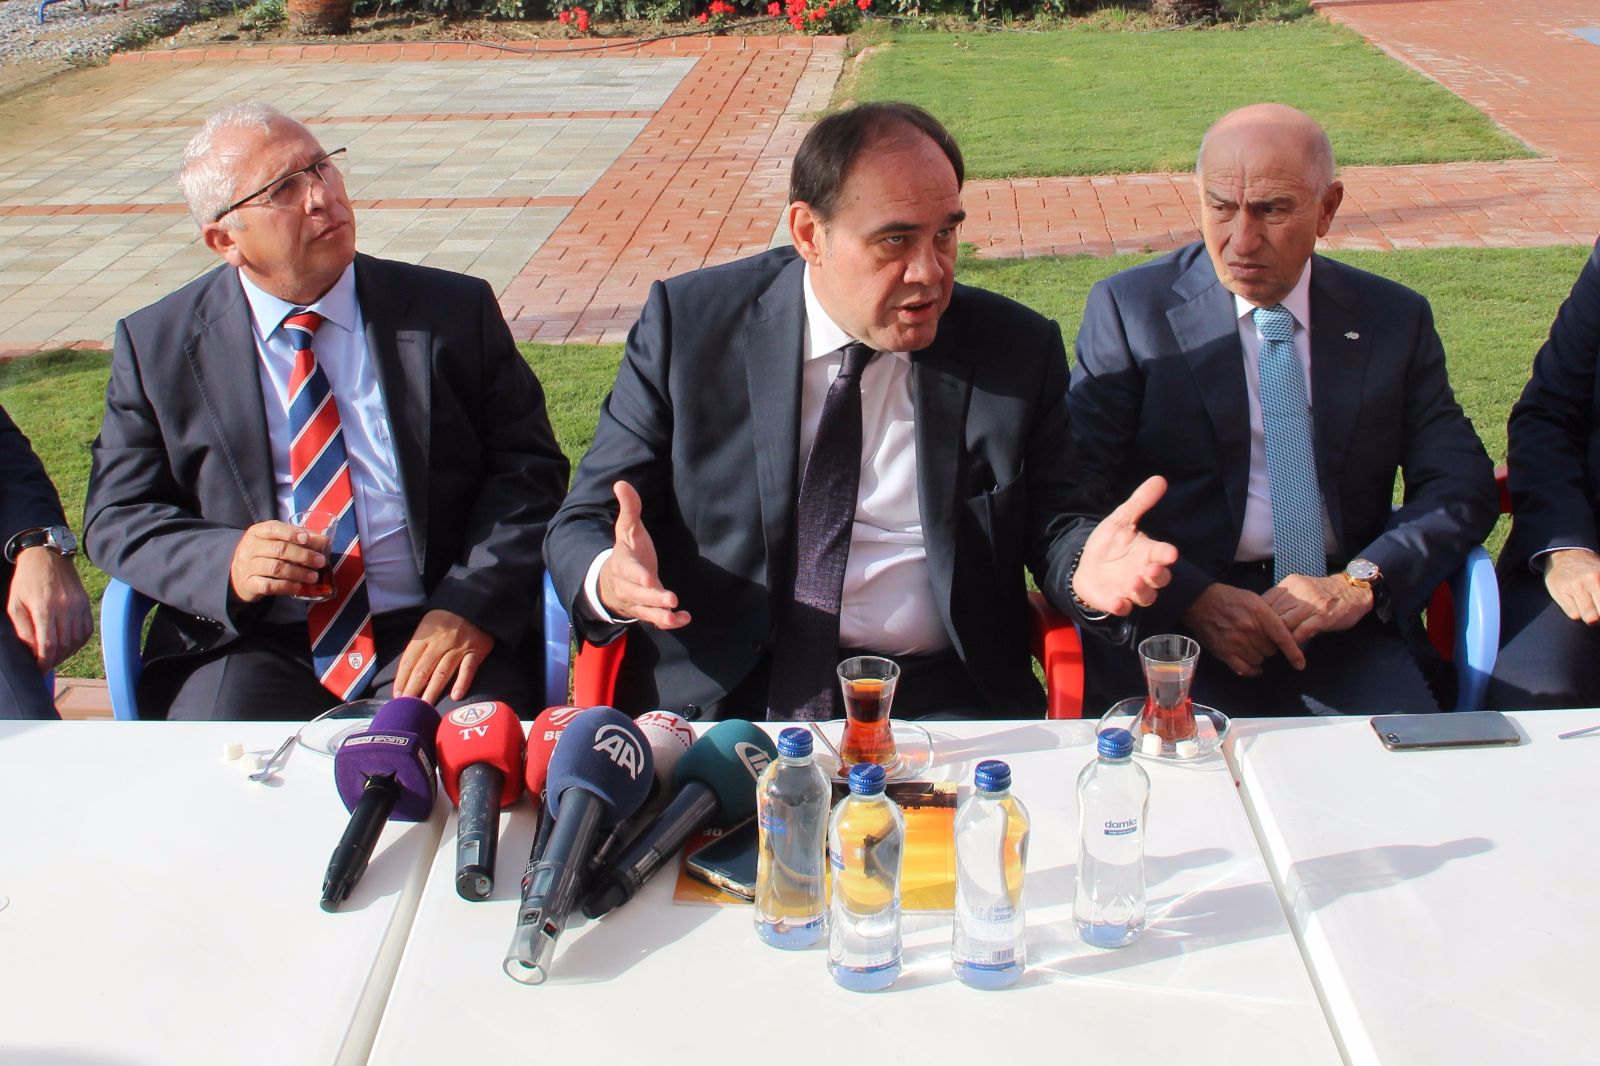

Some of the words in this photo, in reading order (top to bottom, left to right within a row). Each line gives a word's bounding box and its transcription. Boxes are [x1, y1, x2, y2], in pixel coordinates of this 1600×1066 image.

[459, 726, 489, 740] TV
[593, 735, 635, 780] AA
[1104, 818, 1137, 829] damla
